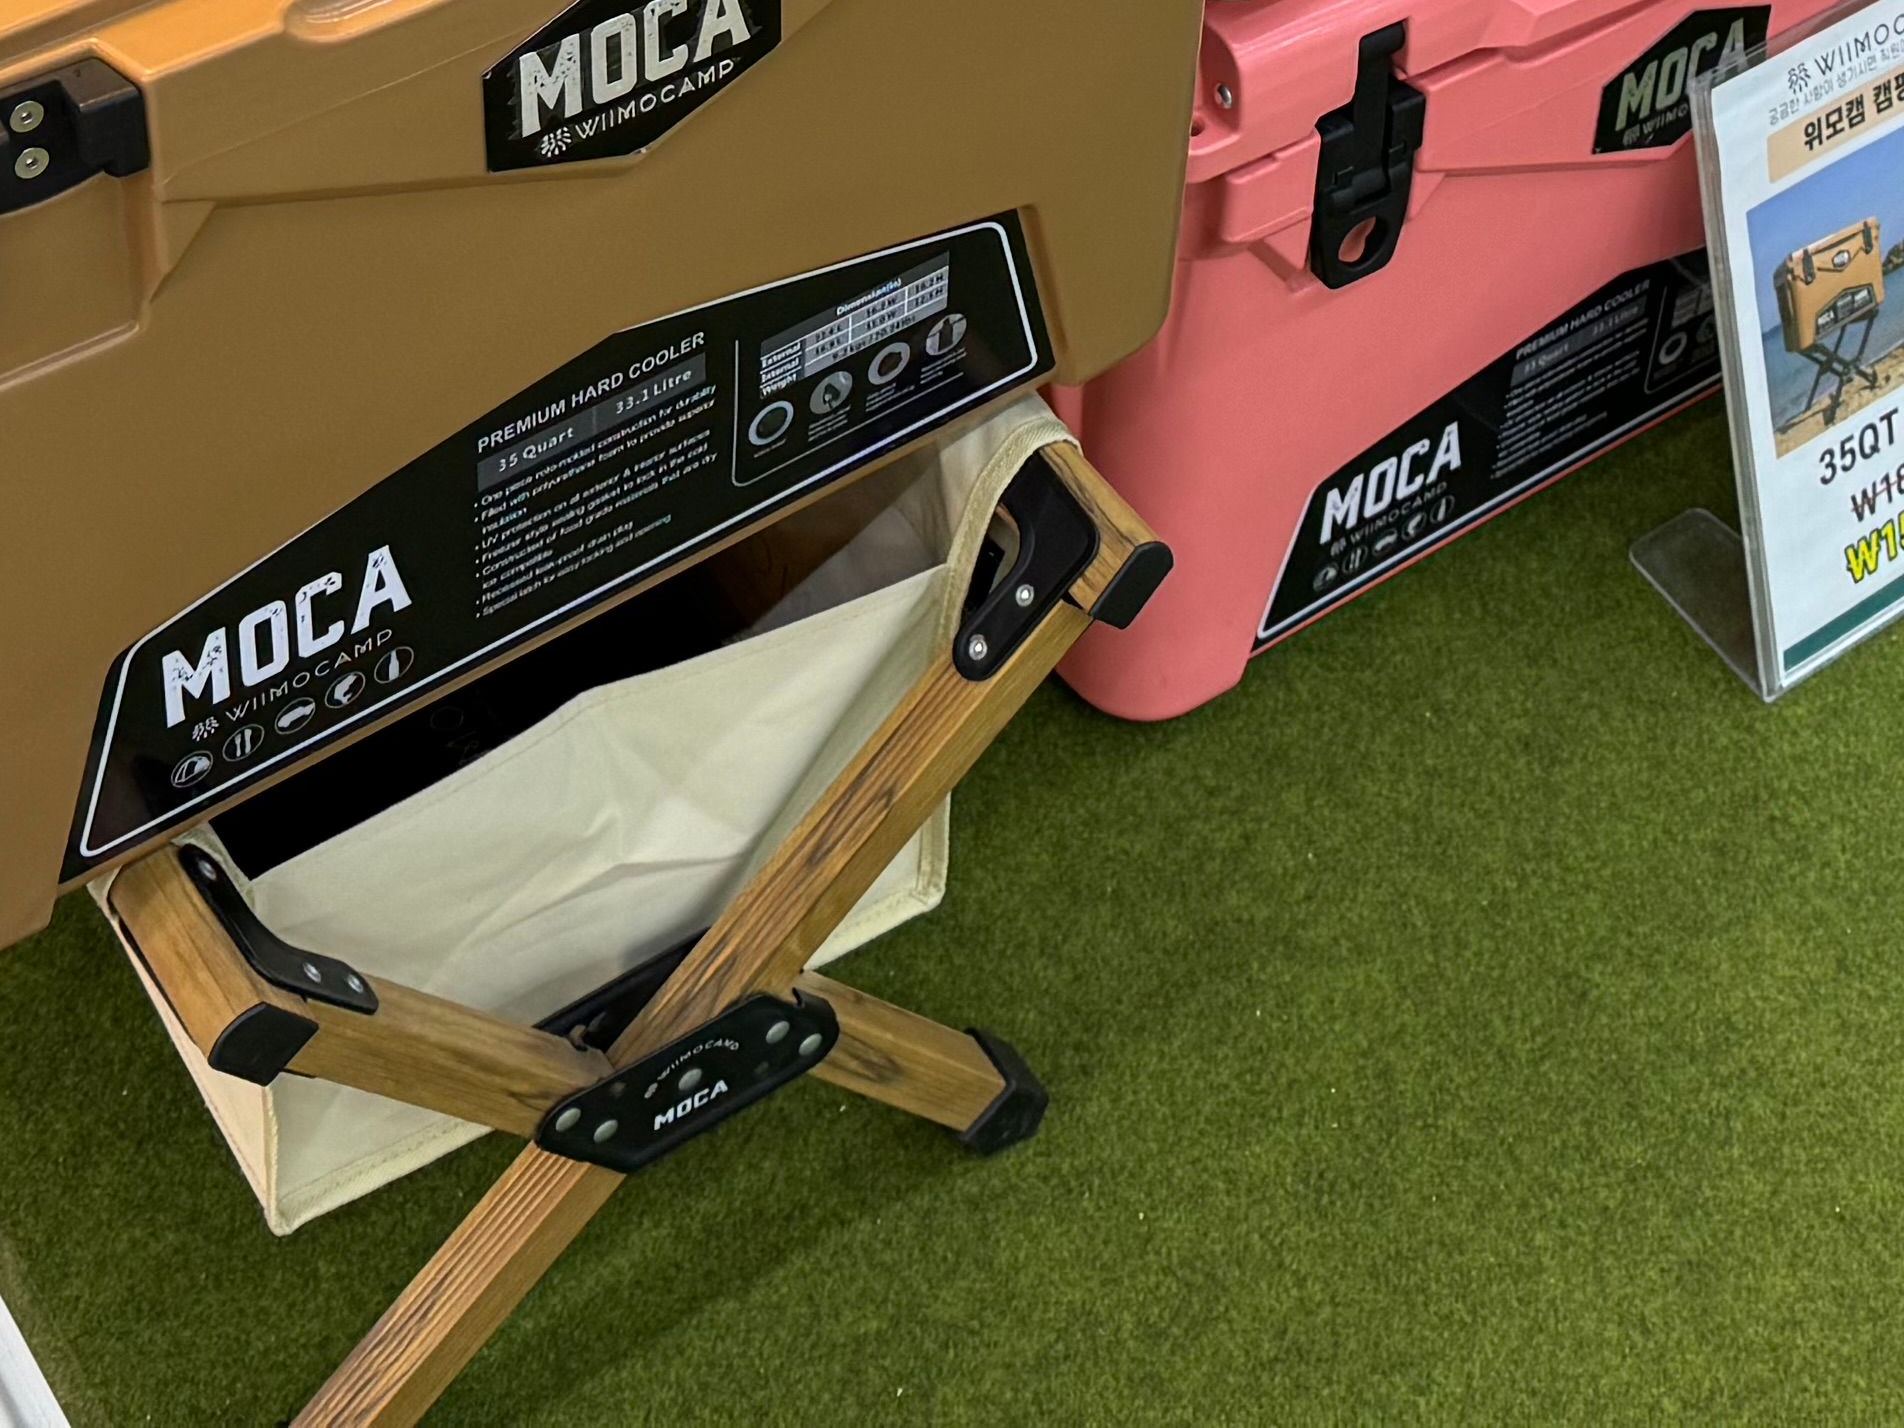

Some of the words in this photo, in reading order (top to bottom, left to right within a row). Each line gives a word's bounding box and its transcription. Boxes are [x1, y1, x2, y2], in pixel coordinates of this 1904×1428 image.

[574, 58, 736, 140] WIIMOCAMP
[1803, 94, 1866, 151] 위모캠
[1515, 322, 1568, 360] PREMIUM
[1570, 304, 1603, 333] HARD
[1604, 279, 1651, 312] COOLER
[477, 400, 566, 454] PREMIUM
[571, 372, 624, 408] HARD
[628, 332, 705, 379] COOLER
[498, 453, 518, 472] 35
[522, 426, 574, 459] Quart
[615, 389, 649, 415] 33.1
[653, 370, 692, 396] Litre
[1319, 421, 1462, 545] MOCA
[1819, 407, 1899, 486] 35QT
[162, 544, 412, 728] MOCA
[226, 629, 392, 721] WIIMOCAMP
[654, 1079, 728, 1131] MOCA
